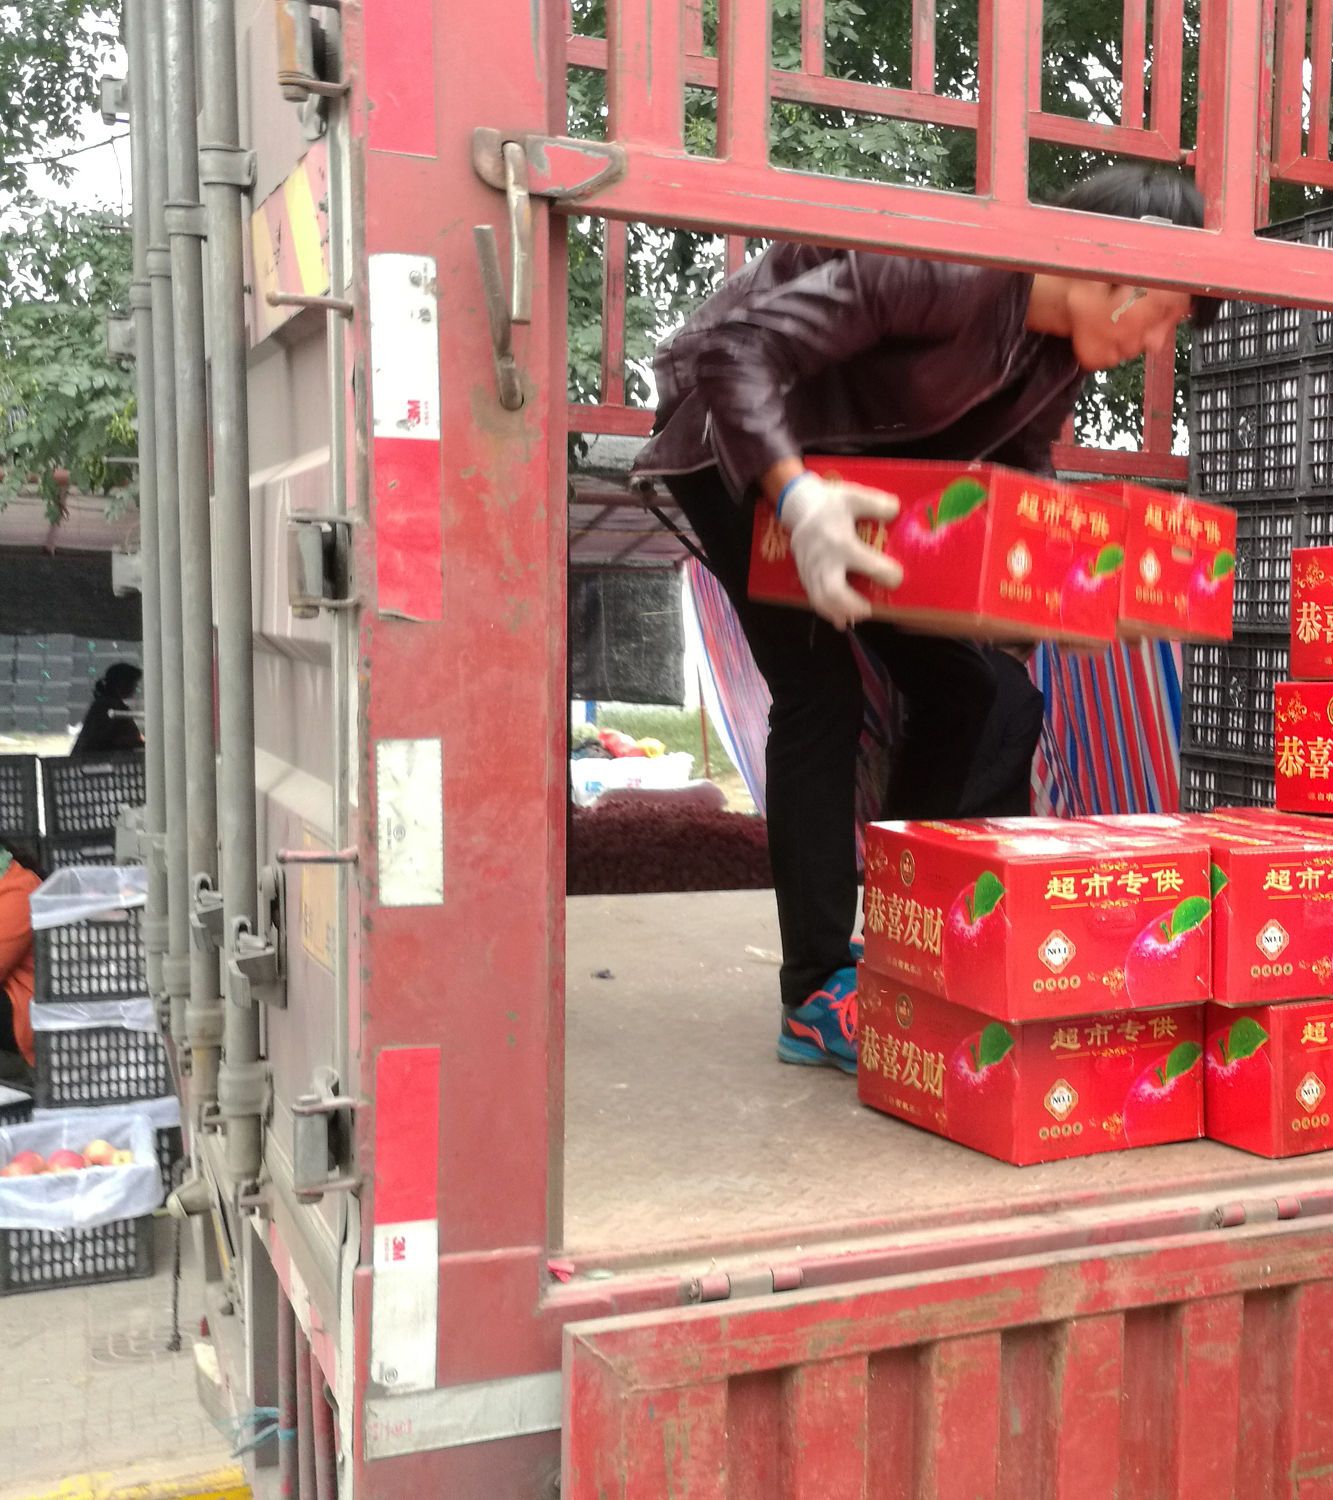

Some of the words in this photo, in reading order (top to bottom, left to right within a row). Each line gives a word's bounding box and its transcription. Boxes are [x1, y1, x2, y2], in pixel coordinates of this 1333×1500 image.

[1044, 868, 1184, 900] 超市专供
[867, 886, 944, 956] 恭喜发财
[1050, 1016, 1178, 1050] 超市专供
[861, 1024, 947, 1100] 恭喜发财
[392, 1236, 406, 1261] 3M
